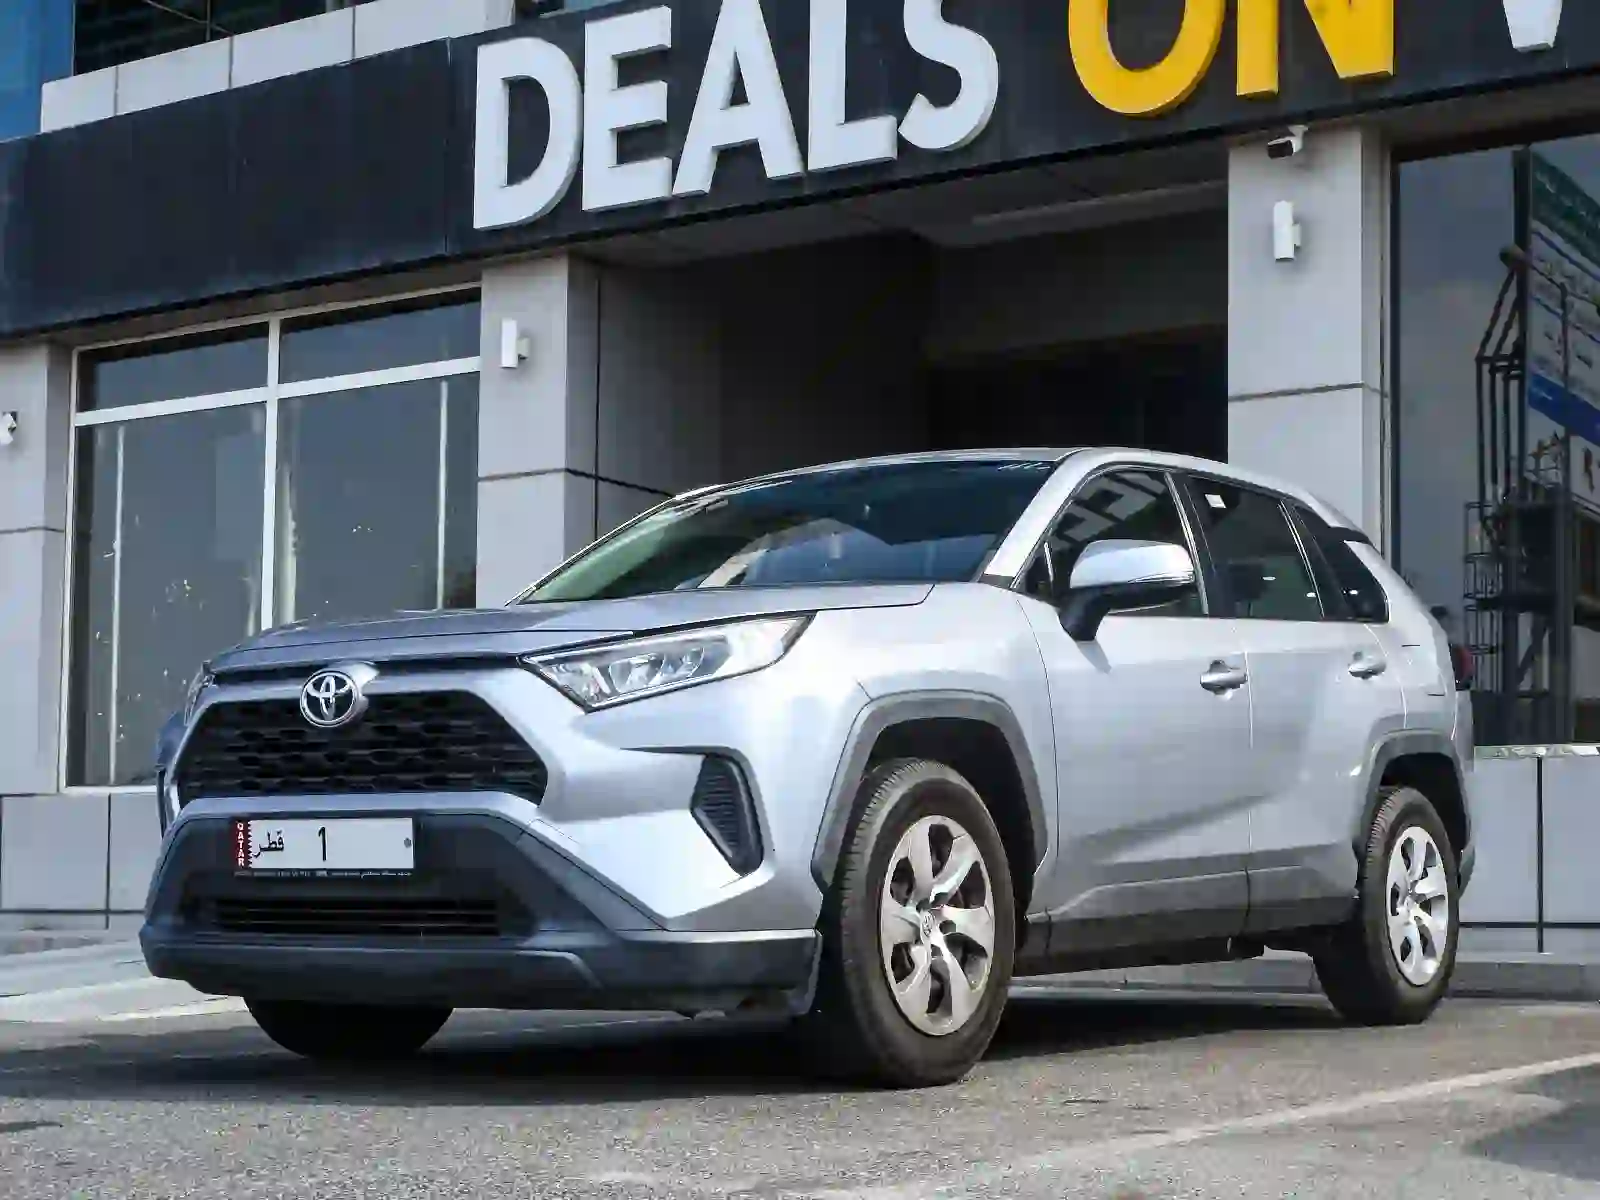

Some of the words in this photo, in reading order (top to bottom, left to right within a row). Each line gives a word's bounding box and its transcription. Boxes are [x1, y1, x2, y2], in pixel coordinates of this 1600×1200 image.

[473, 0, 999, 230] DEALS
[236, 822, 245, 867] QATAR
[252, 829, 285, 859] قطر
[318, 826, 327, 862] 1
